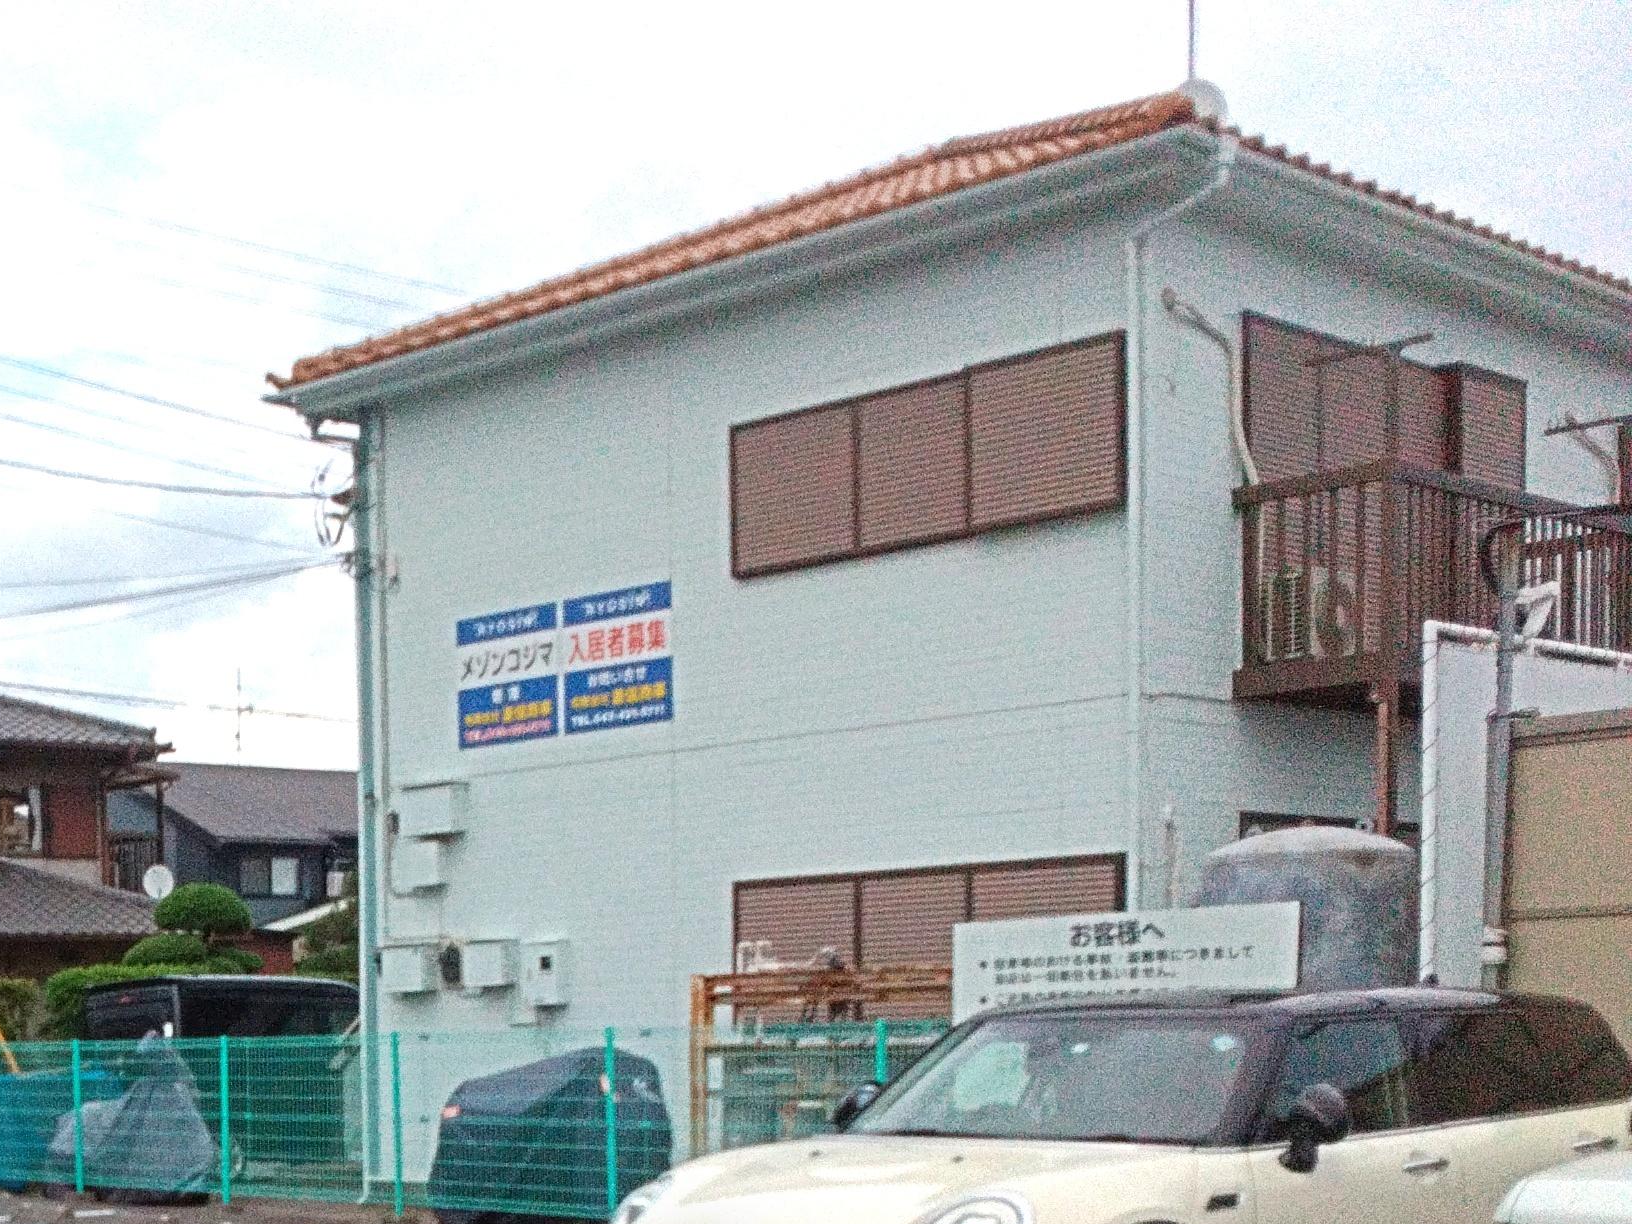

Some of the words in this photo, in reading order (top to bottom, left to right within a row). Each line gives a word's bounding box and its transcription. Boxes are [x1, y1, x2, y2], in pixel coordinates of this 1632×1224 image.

[568, 619, 666, 665] 入居者募集
[1068, 920, 1165, 948] お客様へ
